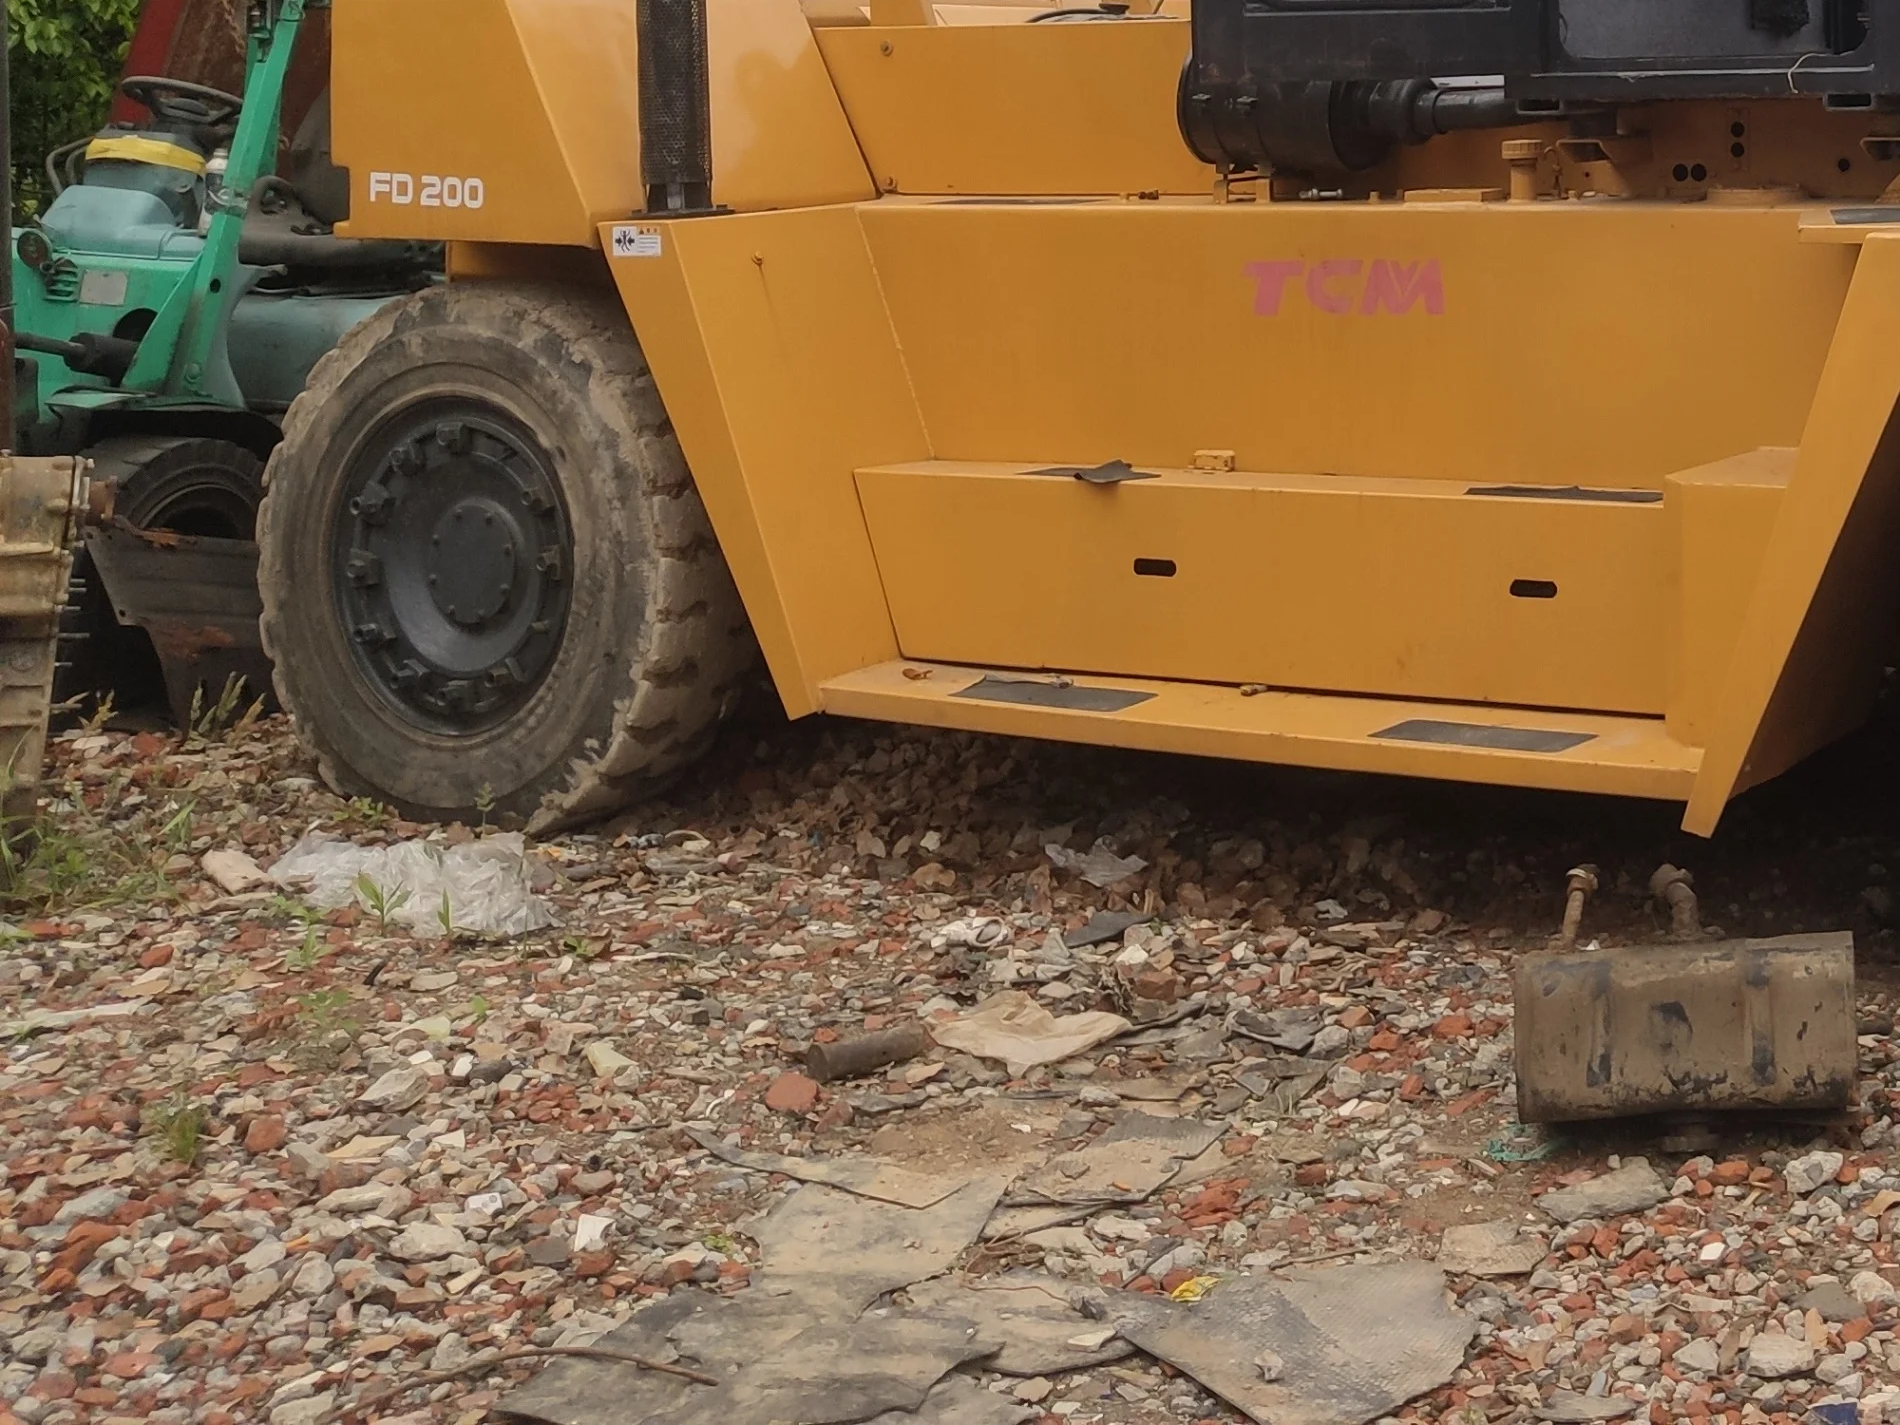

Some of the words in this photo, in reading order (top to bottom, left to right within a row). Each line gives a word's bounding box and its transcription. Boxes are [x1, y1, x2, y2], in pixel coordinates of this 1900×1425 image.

[369, 172, 413, 205] FD
[420, 175, 484, 209] 200
[1242, 258, 1445, 316] TCM
